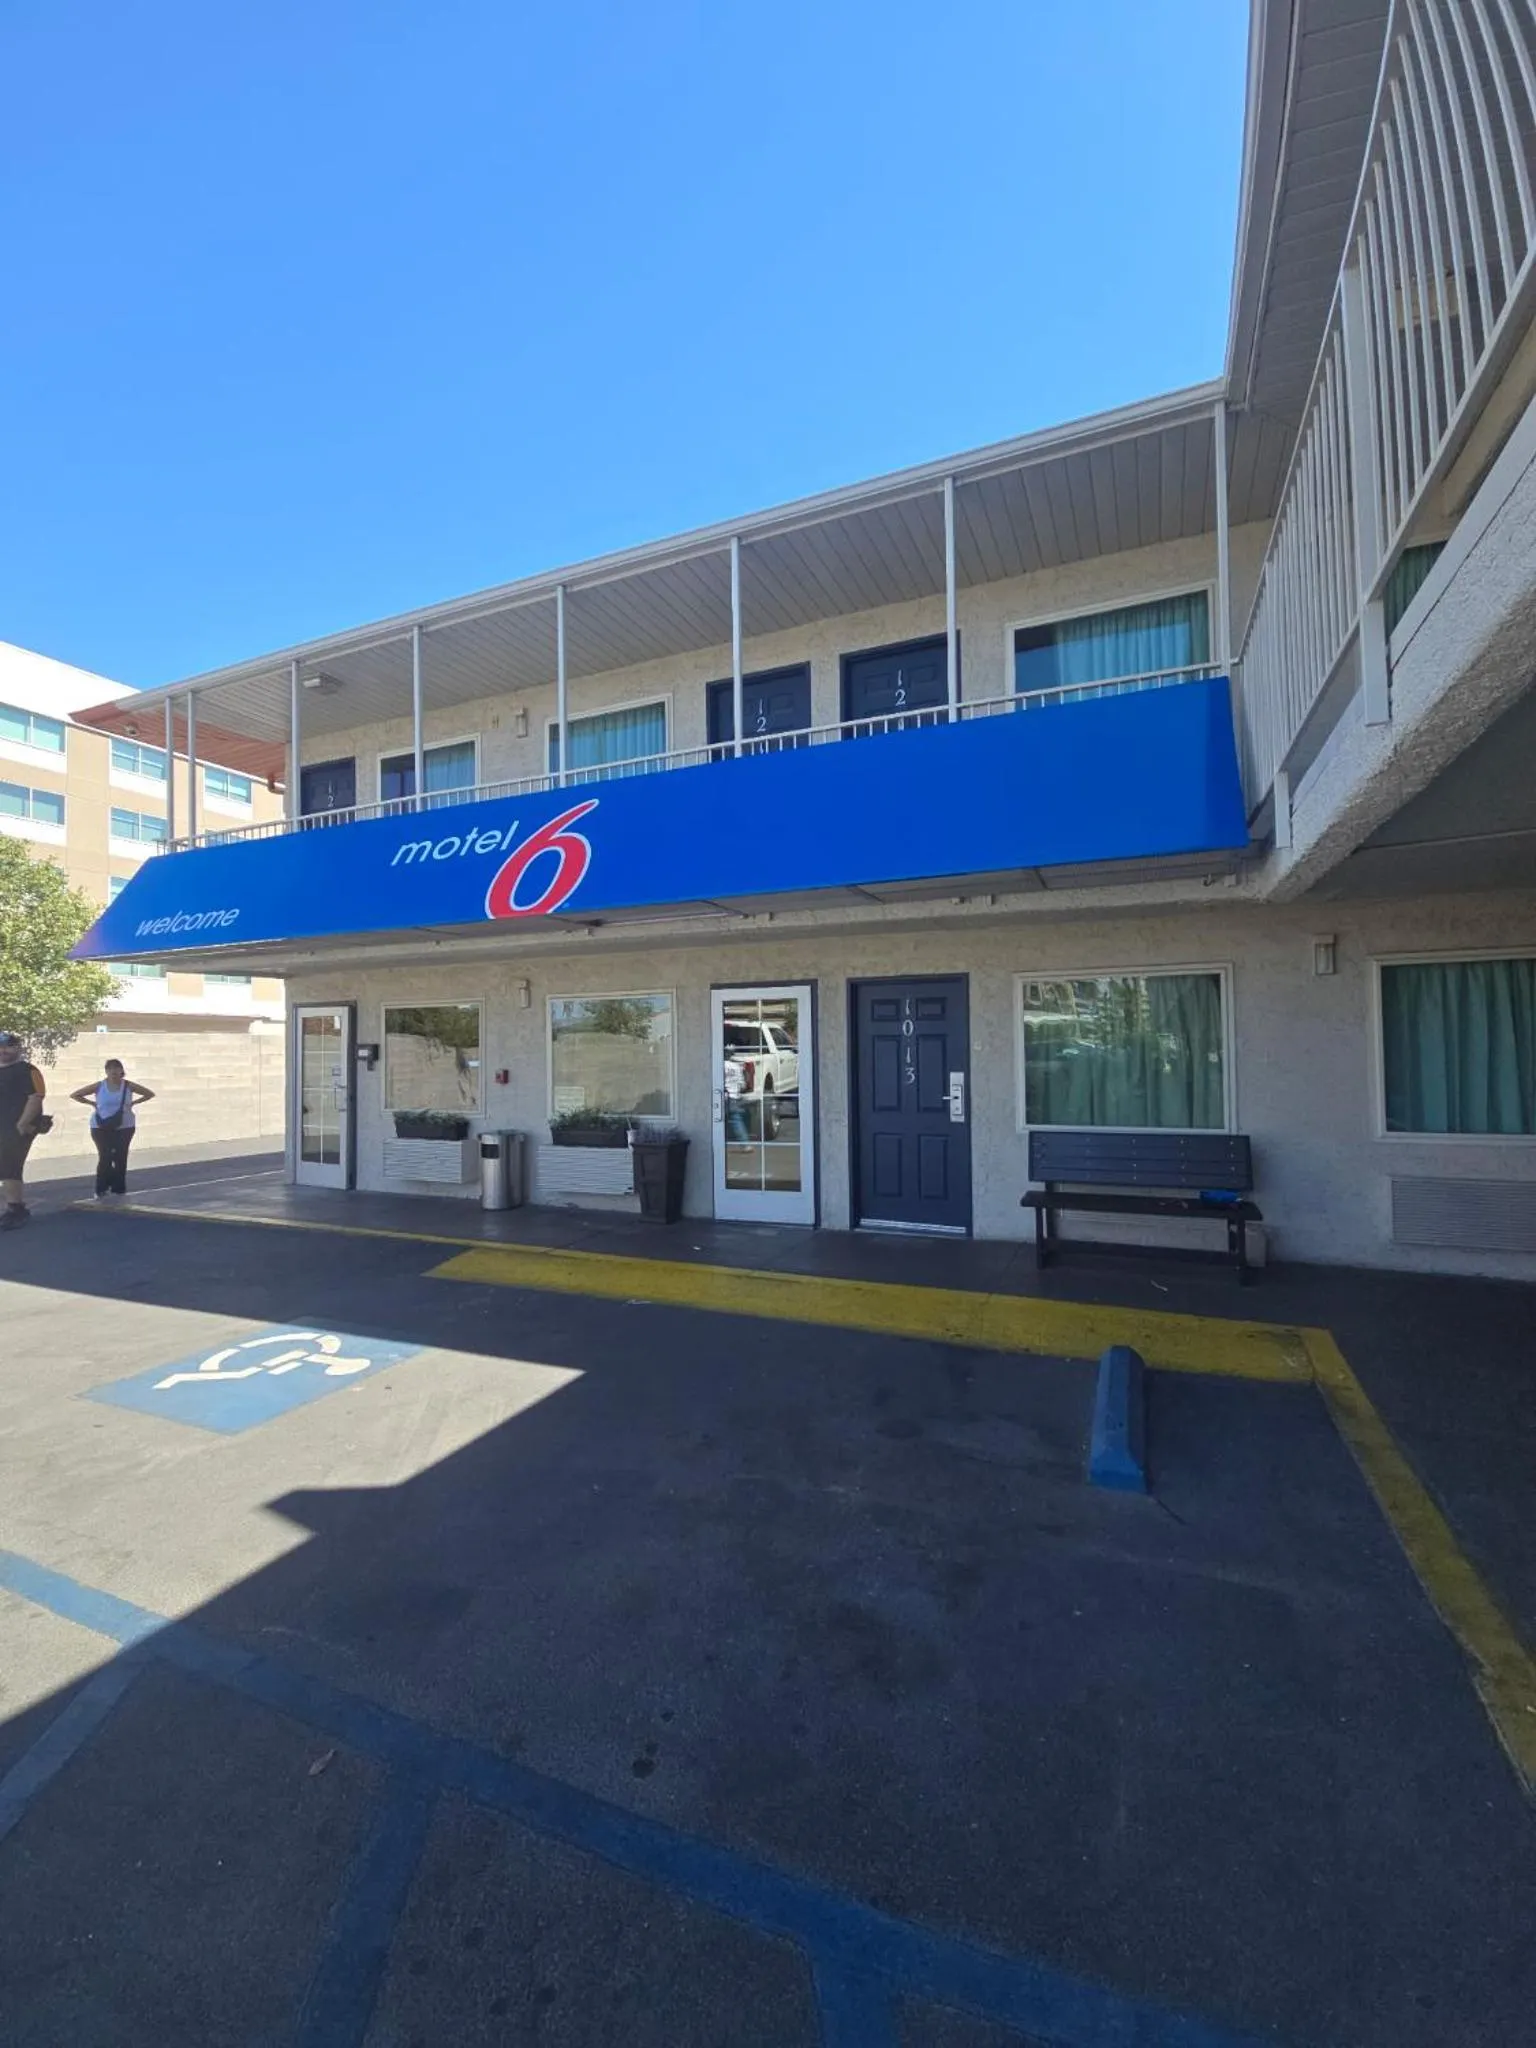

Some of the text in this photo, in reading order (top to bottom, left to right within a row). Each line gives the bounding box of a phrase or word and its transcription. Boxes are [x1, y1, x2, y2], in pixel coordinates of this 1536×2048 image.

[391, 798, 600, 920] motel 6
[135, 905, 240, 938] welcome
